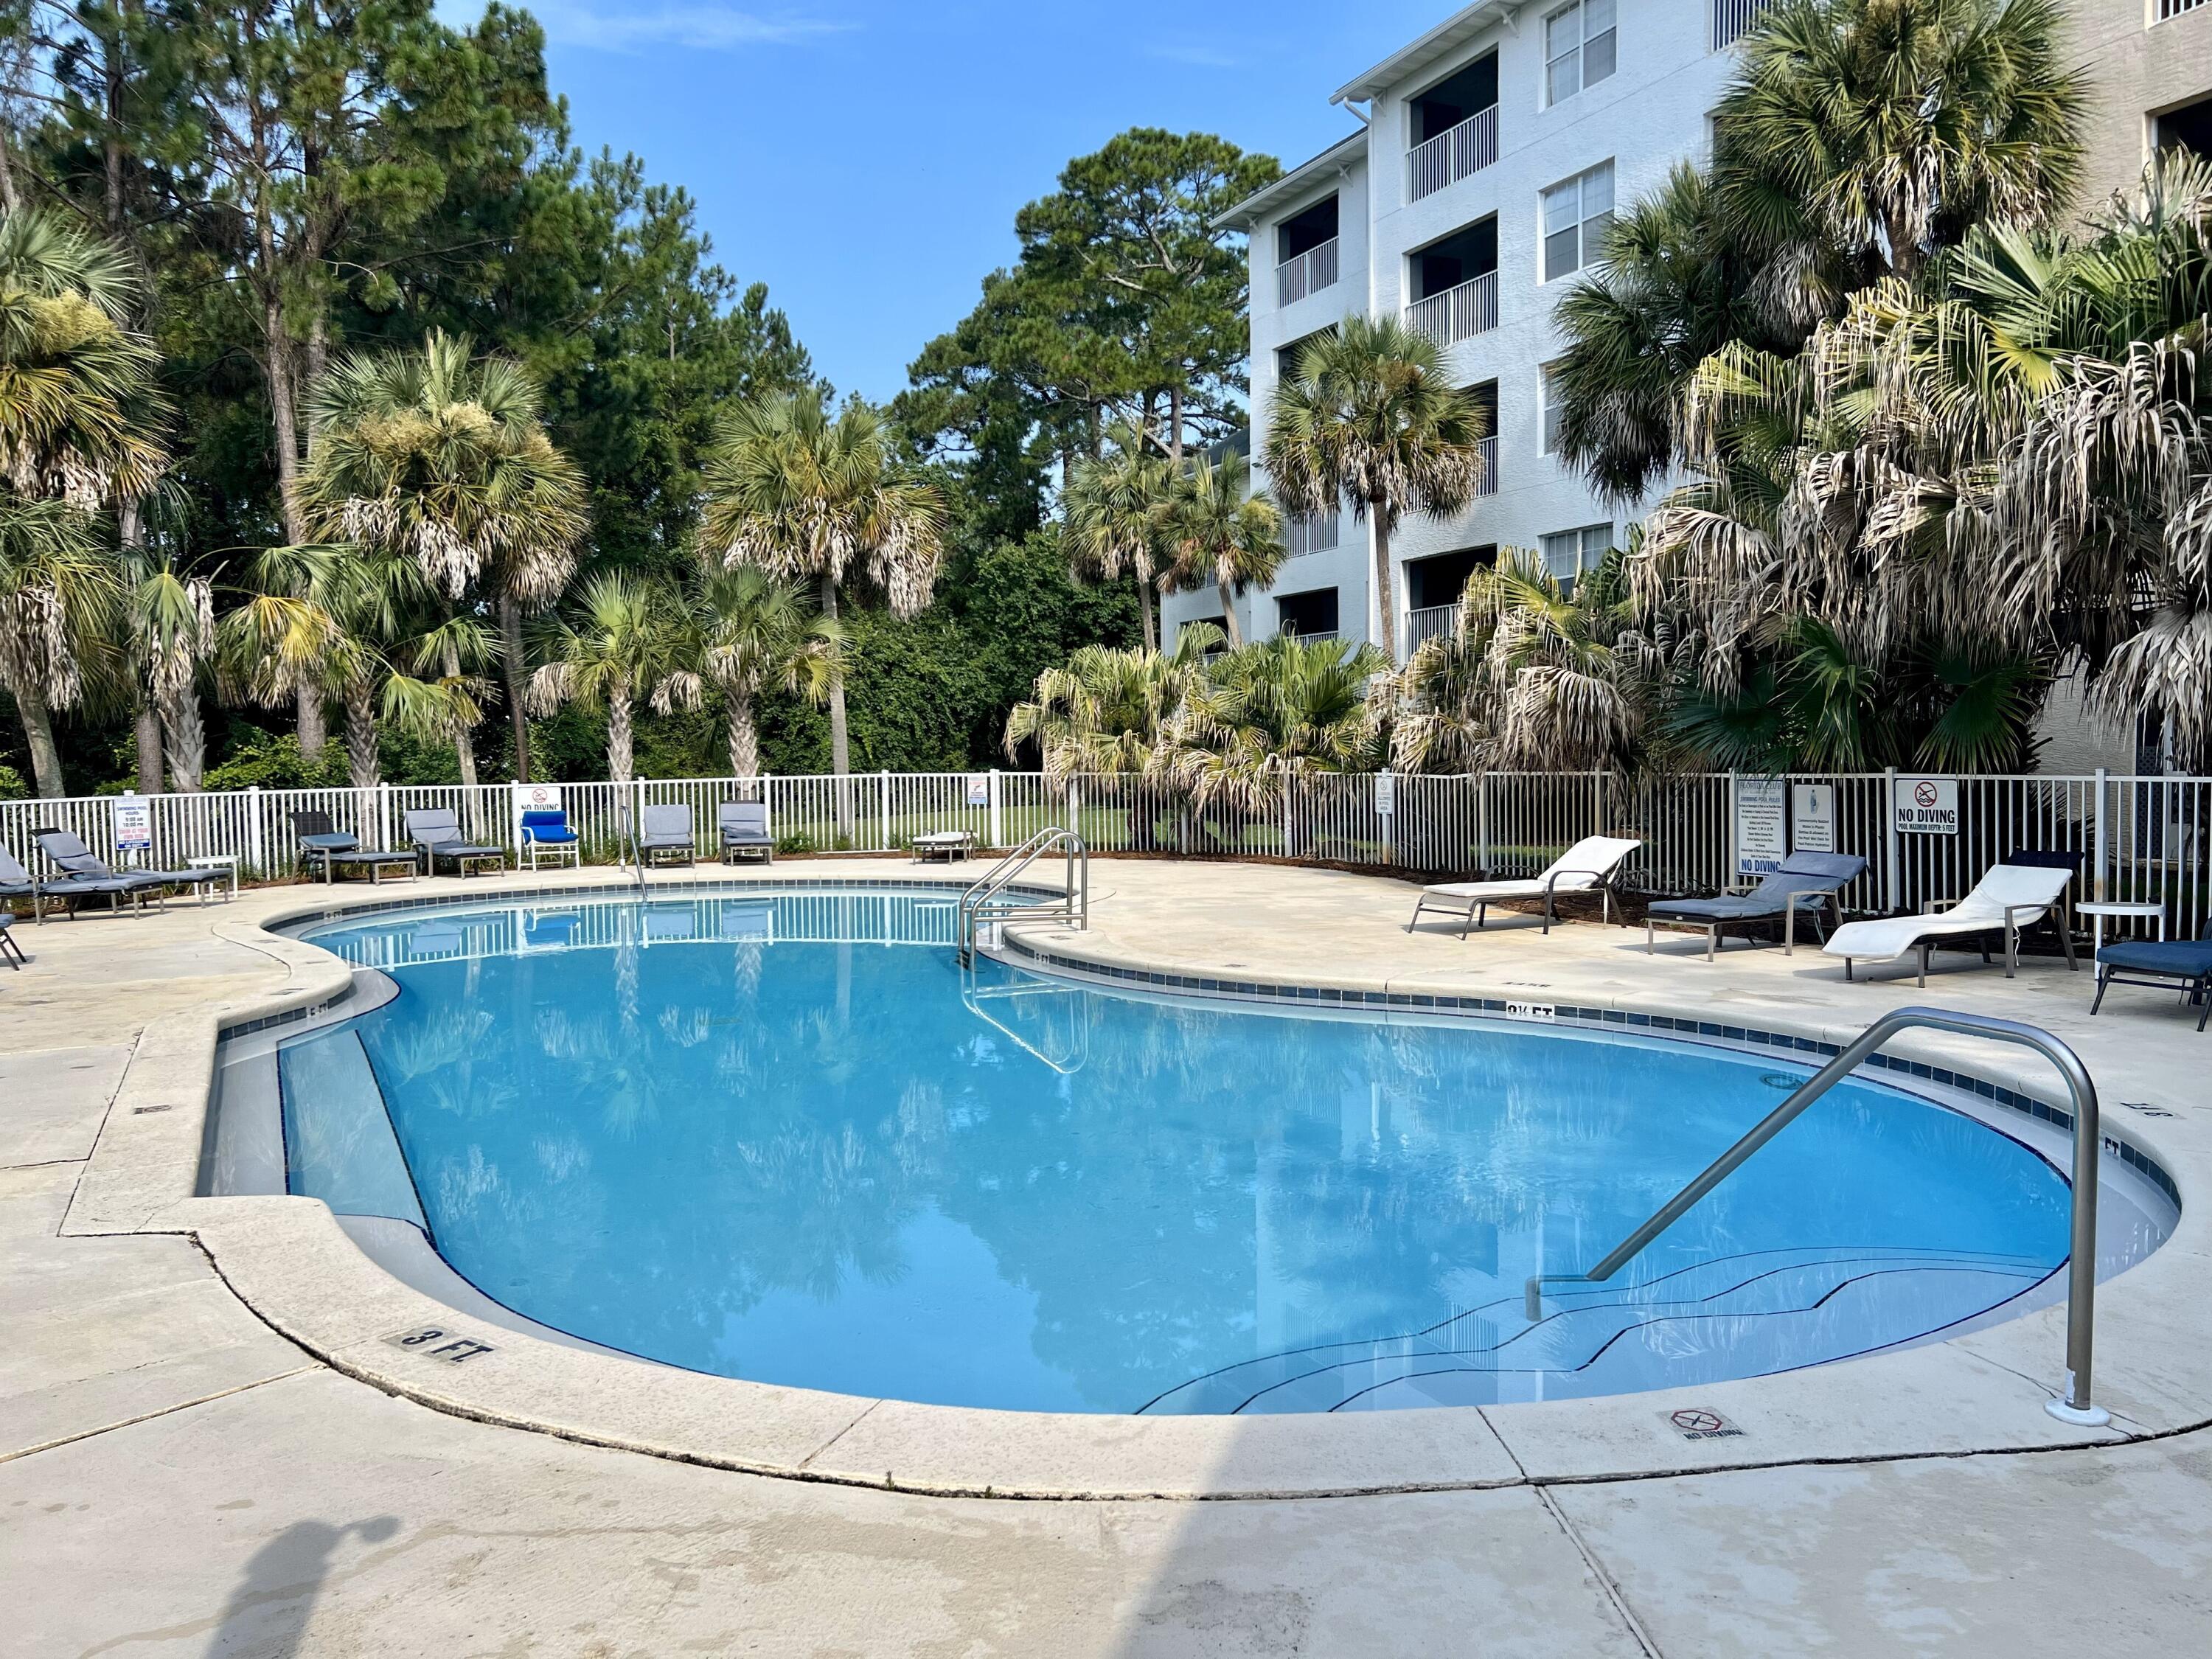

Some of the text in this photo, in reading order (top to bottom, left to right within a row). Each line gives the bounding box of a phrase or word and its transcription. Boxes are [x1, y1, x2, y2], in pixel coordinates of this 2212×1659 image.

[1899, 808, 1955, 824] NO DIVING
[1742, 859, 1781, 872] NO DIVING
[2105, 1136, 2119, 1155] FT
[401, 1330, 444, 1345] 3
[1683, 1429, 1745, 1440] NO DIVING
